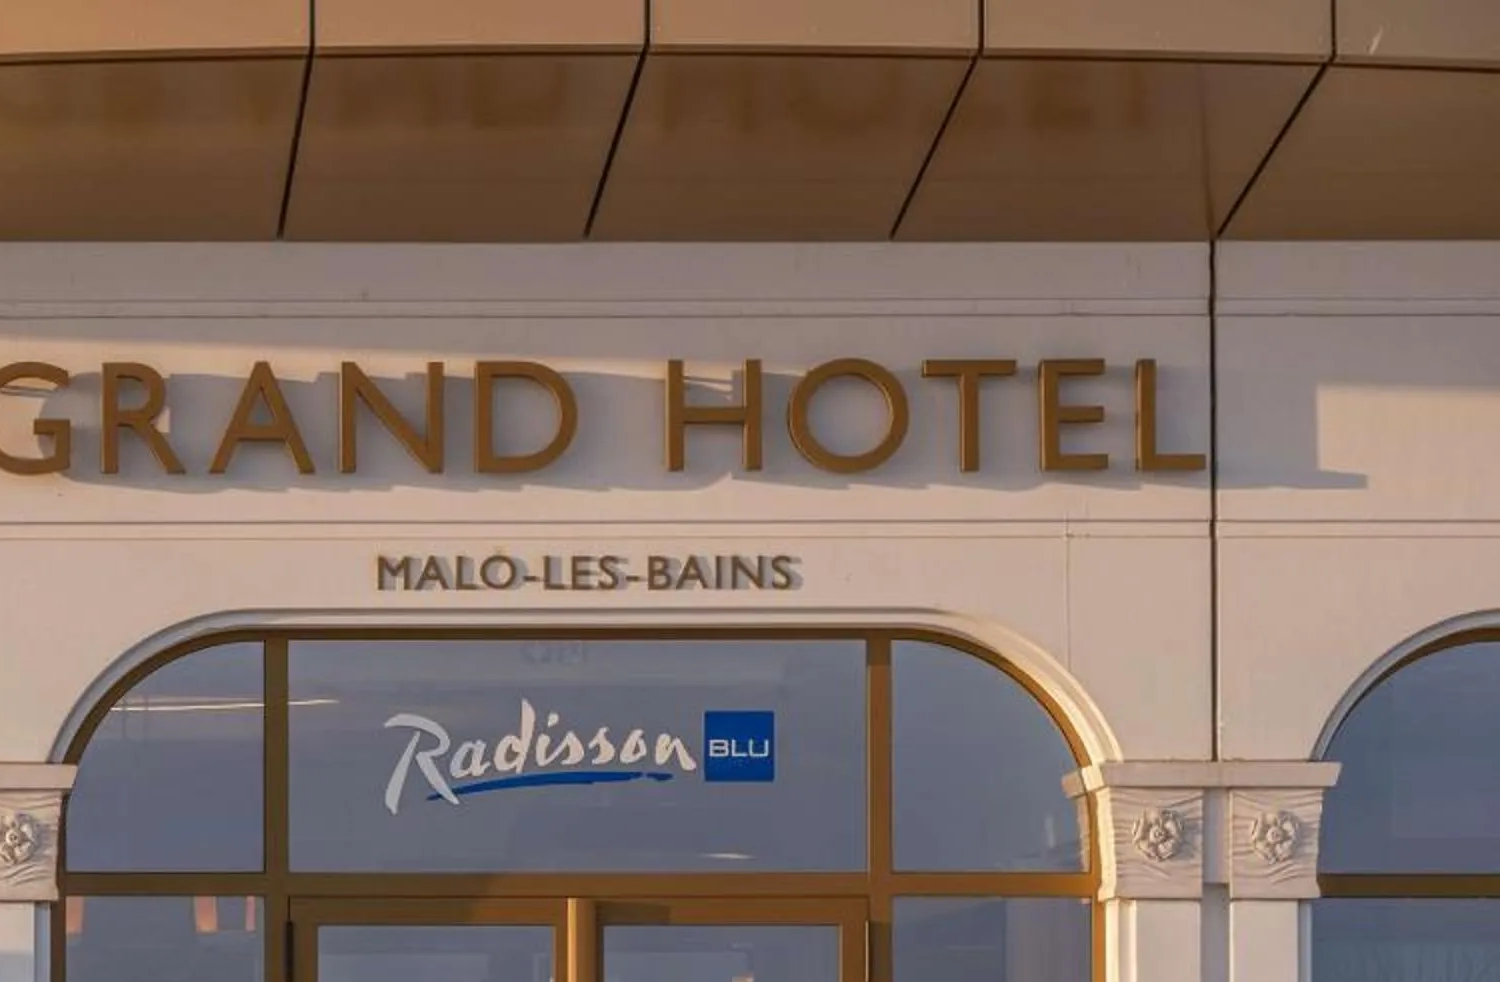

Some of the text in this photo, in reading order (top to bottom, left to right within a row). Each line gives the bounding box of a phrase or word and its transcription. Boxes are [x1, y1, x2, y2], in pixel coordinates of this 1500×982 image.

[663, 357, 1207, 474] HOTEL
[375, 554, 798, 591] MALO-LES-BAINS
[383, 697, 769, 815] Radisson BLU
